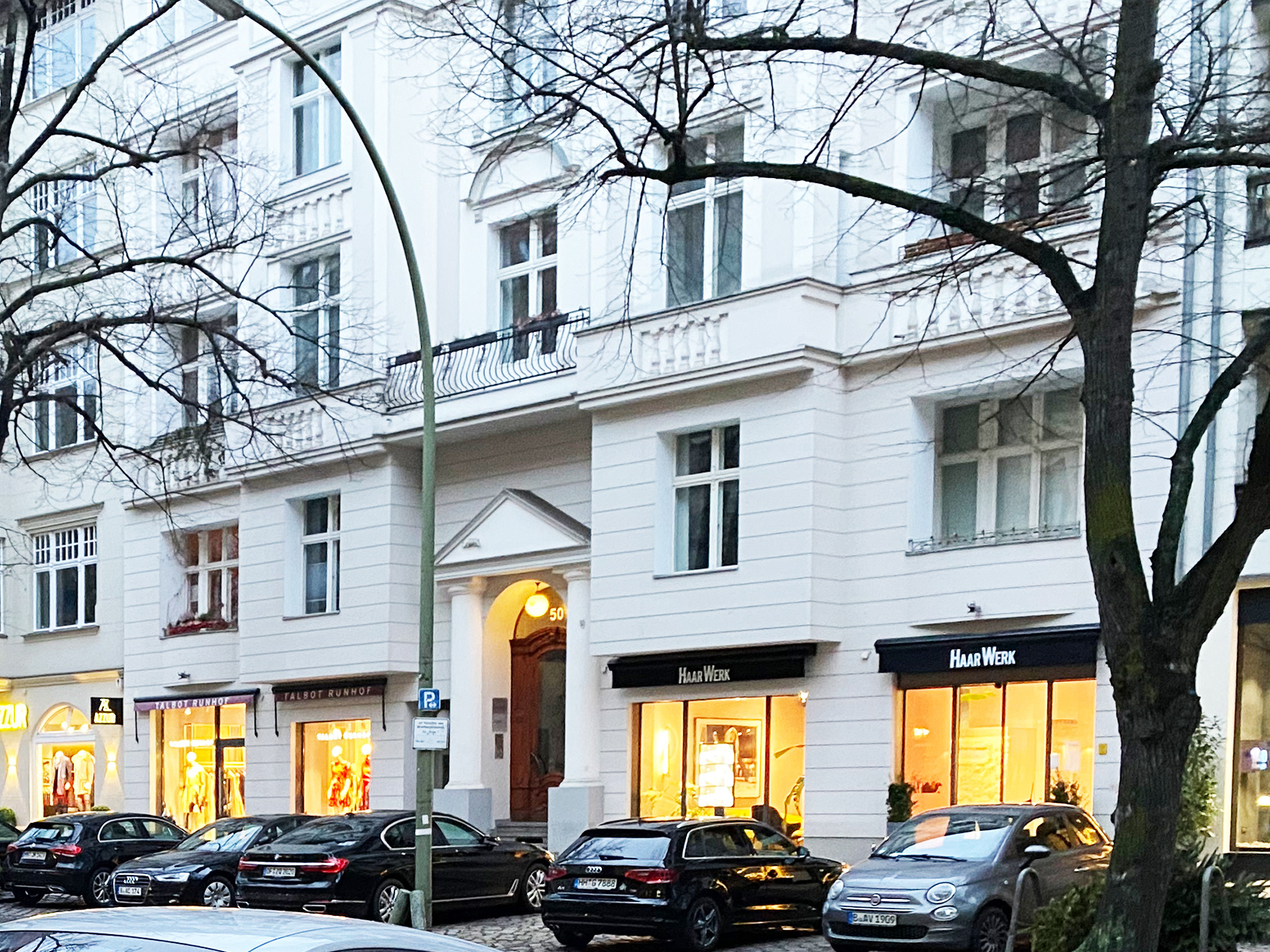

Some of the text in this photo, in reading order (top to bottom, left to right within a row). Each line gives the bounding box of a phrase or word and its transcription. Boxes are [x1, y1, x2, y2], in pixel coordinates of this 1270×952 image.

[549, 606, 564, 621] 50
[284, 686, 372, 701] TALBOT RUNHOF
[423, 691, 436, 709] P
[155, 697, 230, 710] TALBOT RUNHOF
